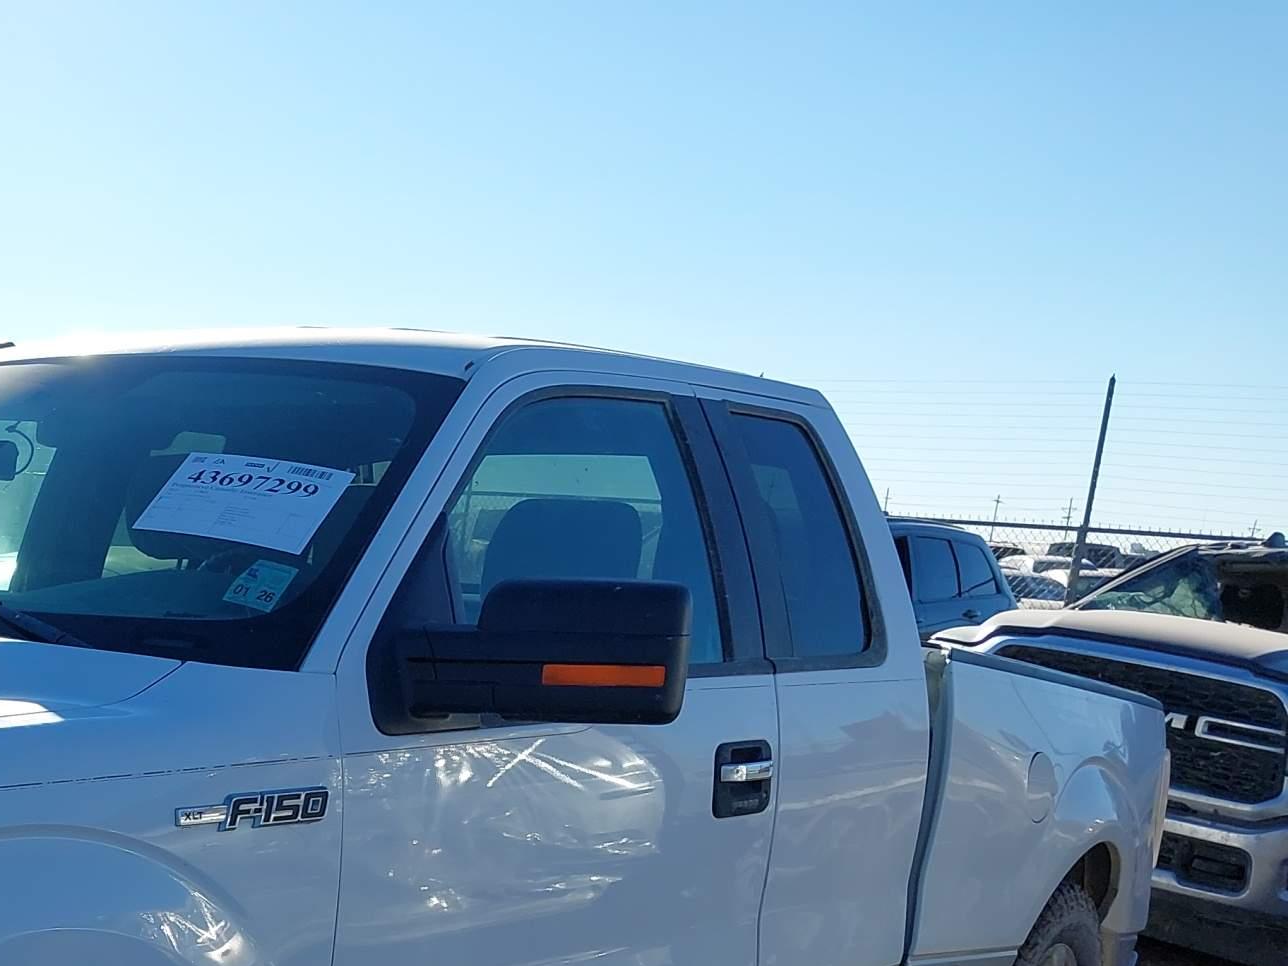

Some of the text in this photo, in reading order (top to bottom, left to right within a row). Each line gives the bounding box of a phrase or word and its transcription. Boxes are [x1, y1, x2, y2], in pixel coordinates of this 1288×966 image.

[187, 468, 320, 498] 43697299
[233, 584, 275, 603] 01 26
[184, 789, 331, 829] XLT F-150
